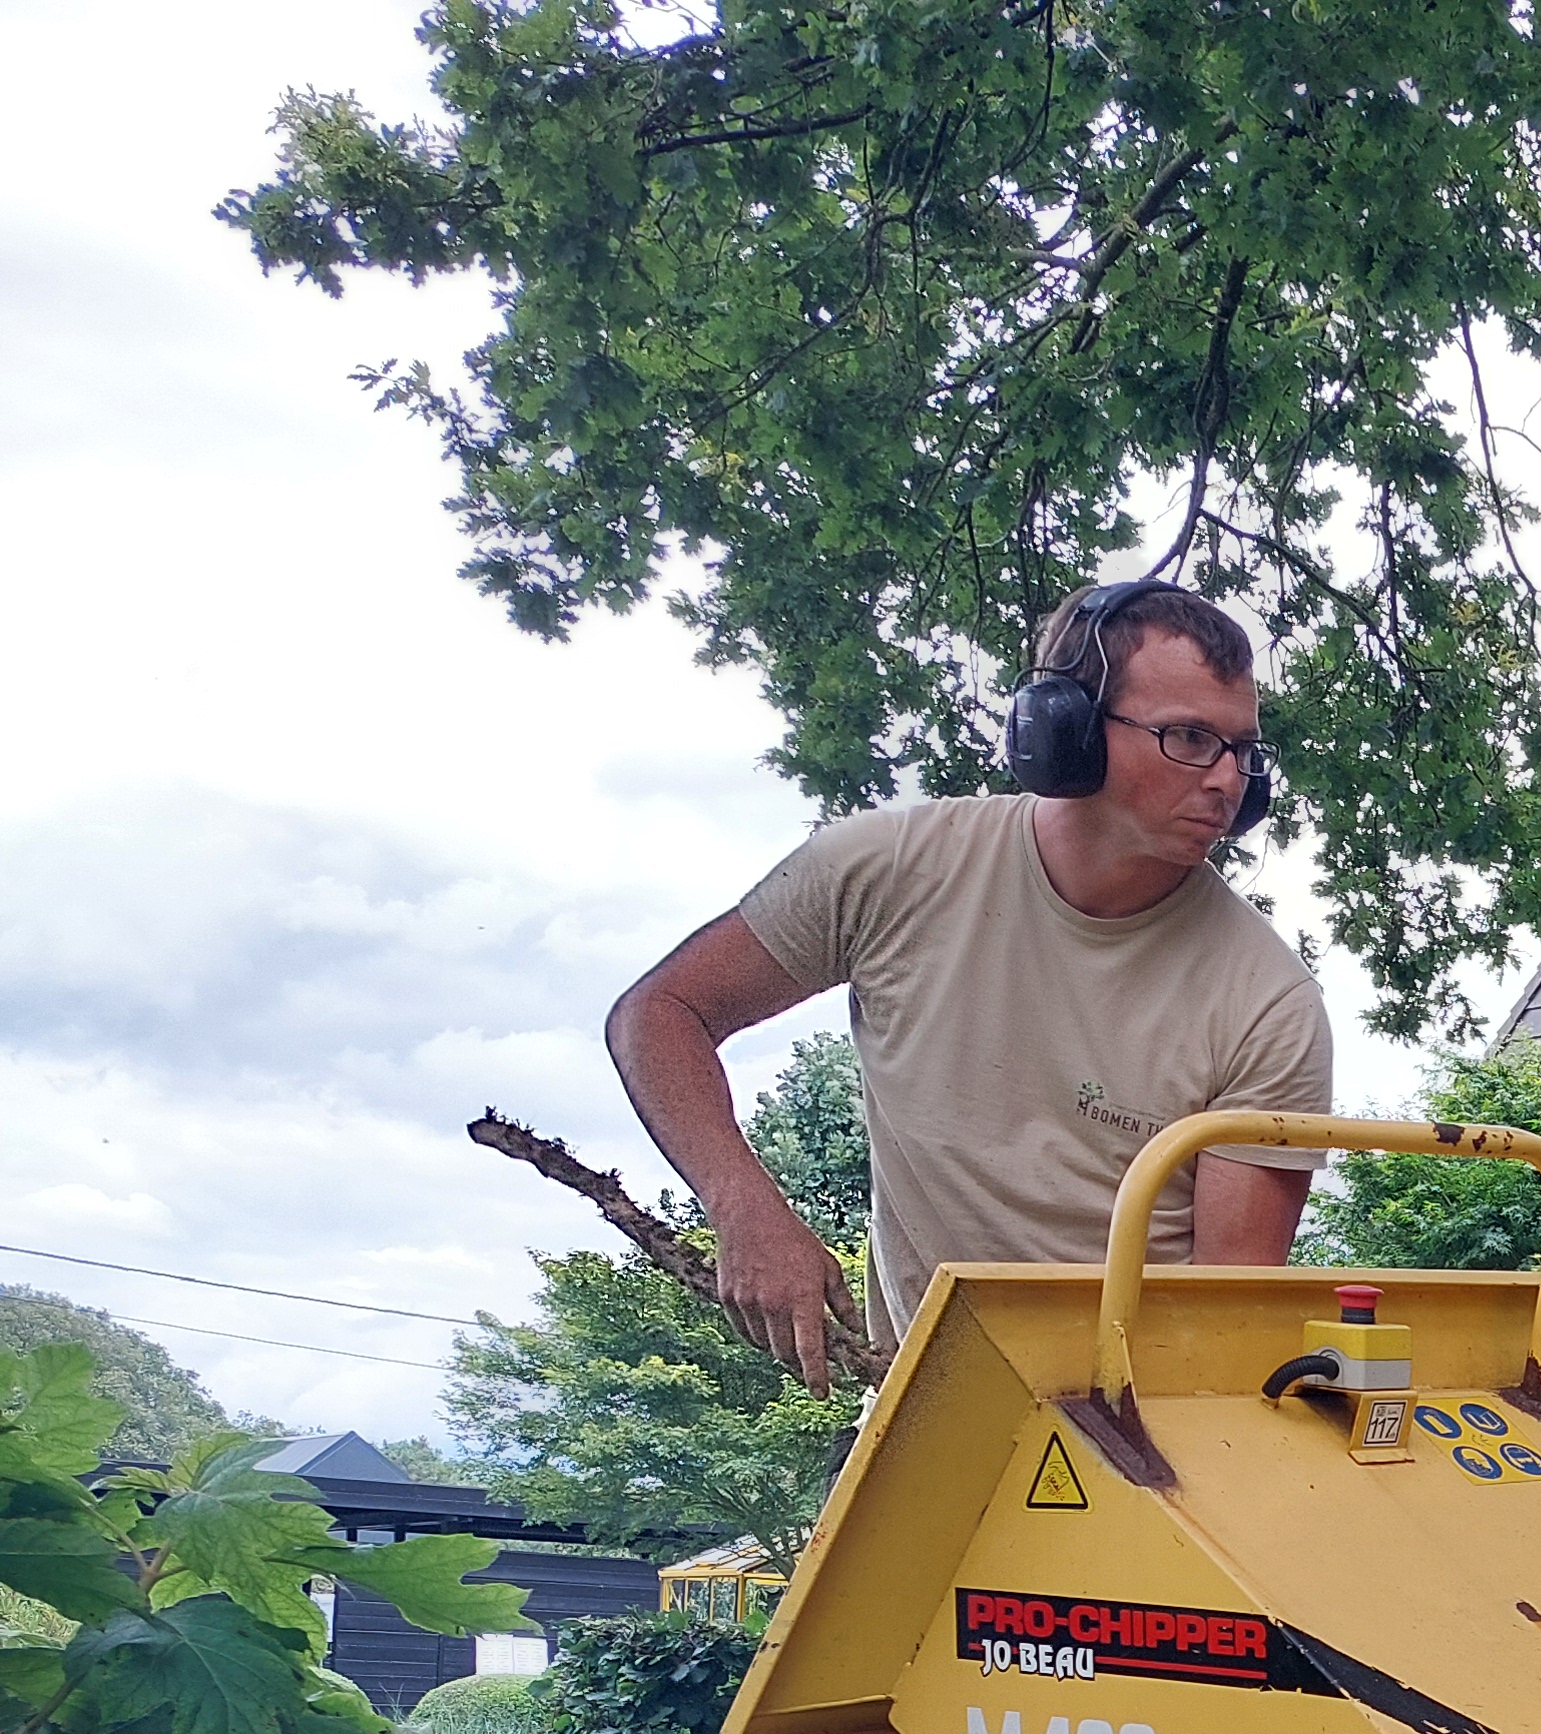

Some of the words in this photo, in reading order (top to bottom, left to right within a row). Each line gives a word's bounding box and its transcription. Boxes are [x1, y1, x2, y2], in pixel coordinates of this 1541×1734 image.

[1091, 1106, 1140, 1132] BOMEN
[1371, 1417, 1398, 1439] 117
[968, 1595, 1267, 1659] PRO-CHIPPER
[981, 1639, 1011, 1675] JO
[1019, 1642, 1094, 1678] BEAU
